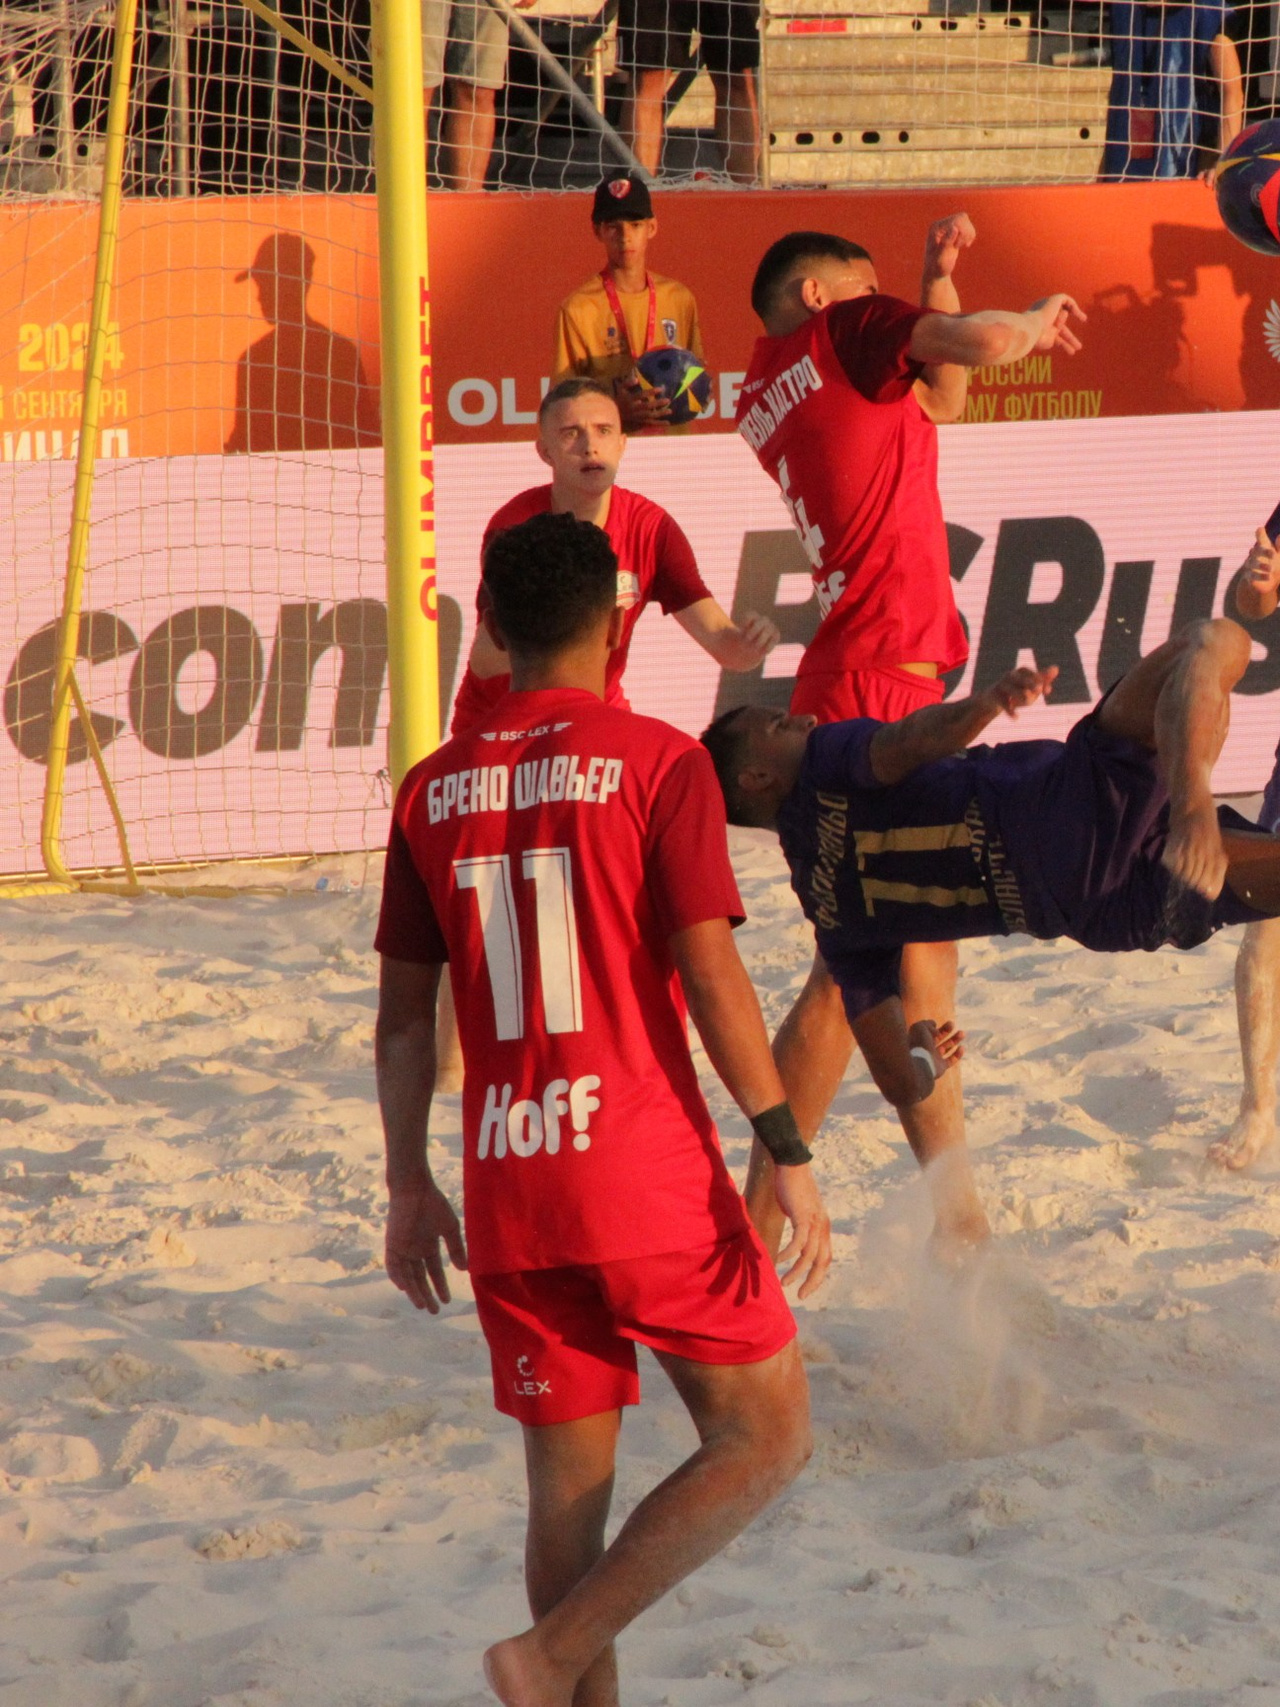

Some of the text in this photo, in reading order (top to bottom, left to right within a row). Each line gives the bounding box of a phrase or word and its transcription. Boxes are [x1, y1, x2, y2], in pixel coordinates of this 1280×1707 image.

[1005, 390, 1102, 422] ФУТБОЛУ
[500, 724, 551, 742] BSC LEX
[427, 755, 623, 825] БРЕНО ШАВЬЕР
[852, 821, 990, 918] 11
[452, 846, 583, 1042] 11
[513, 1380, 552, 1396] LEX
